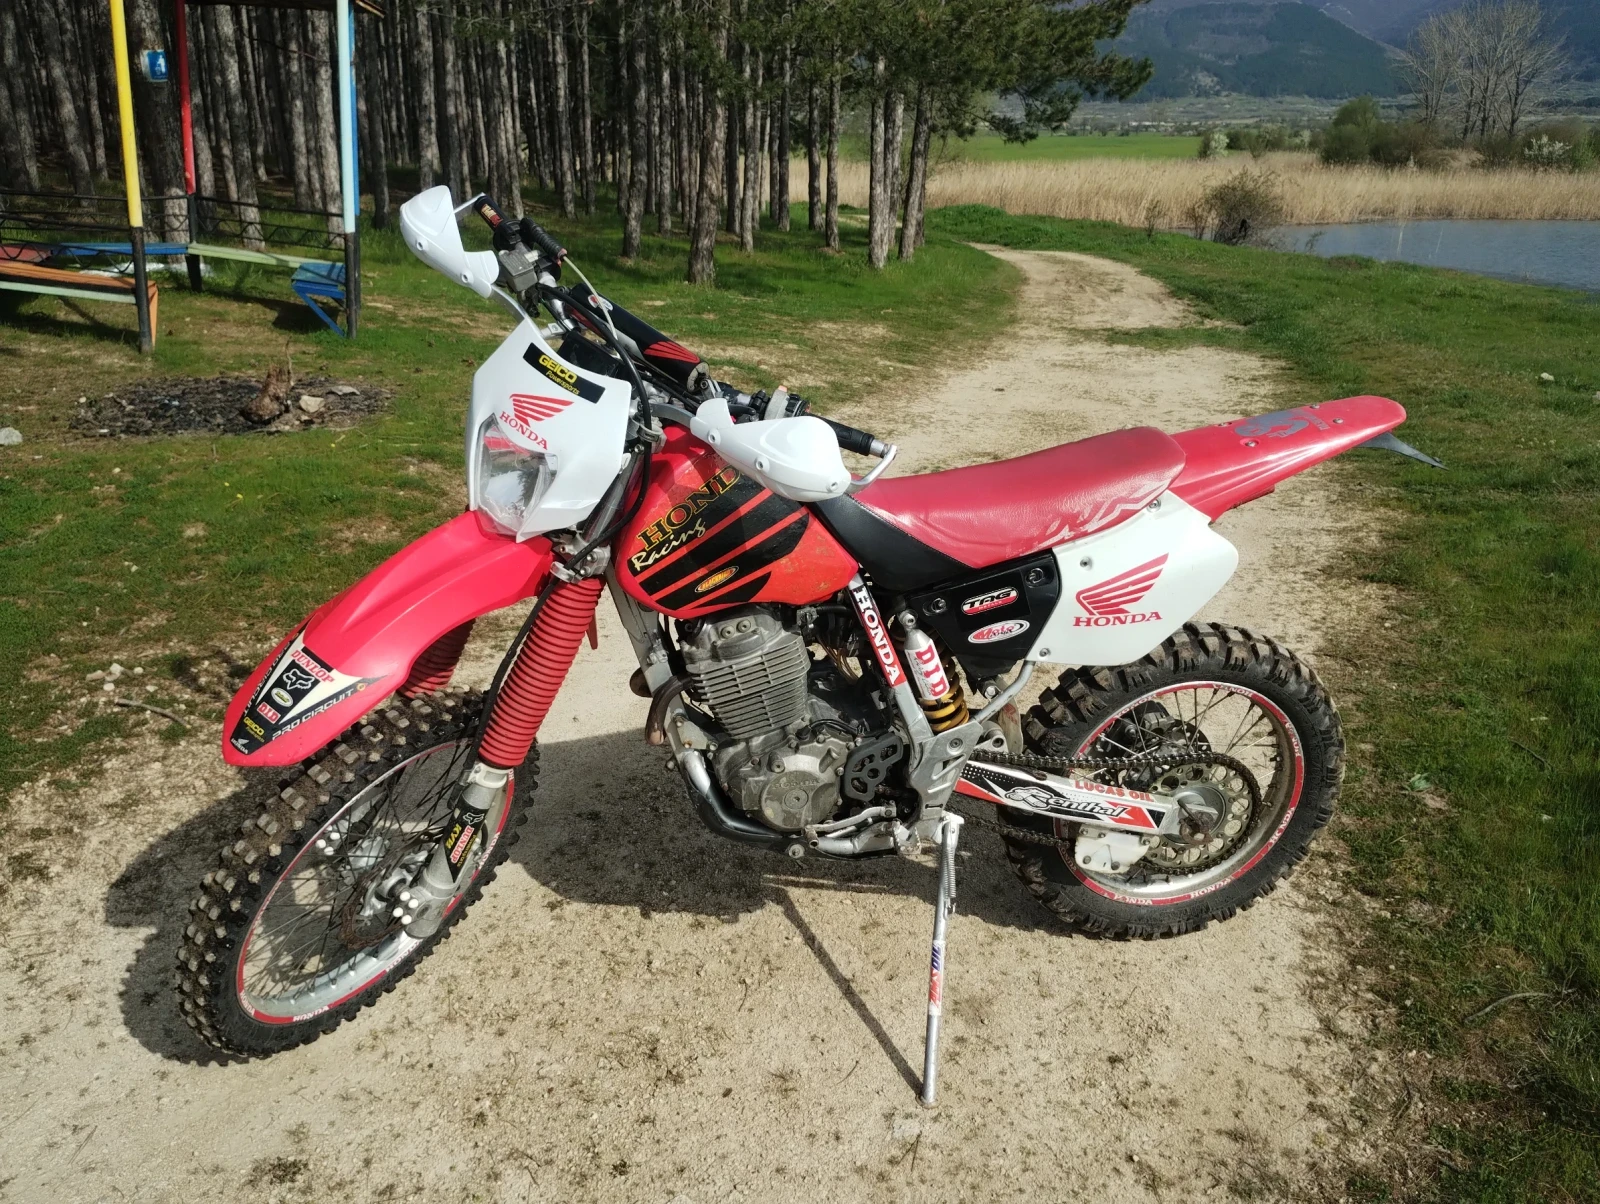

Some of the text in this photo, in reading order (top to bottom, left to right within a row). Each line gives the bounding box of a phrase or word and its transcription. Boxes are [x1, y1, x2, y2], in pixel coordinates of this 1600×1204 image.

[538, 354, 578, 384] GEICO
[546, 370, 581, 396] Powersports
[499, 410, 548, 451] HONDA
[636, 465, 742, 551] HOND
[631, 518, 707, 571] Racing
[964, 588, 1014, 609] TAG
[1073, 611, 1163, 627] HONDA
[853, 585, 901, 685] HONDA
[291, 649, 335, 683] DUNLOP
[915, 644, 948, 697] DID
[244, 717, 265, 736] GEICO
[257, 702, 280, 723] DID
[272, 719, 300, 740] PRO
[302, 688, 354, 723] CIRCUIT
[1075, 780, 1155, 803] LUCAS OIL
[450, 825, 475, 864] DUNLOP
[1190, 878, 1233, 899] HONDA
[293, 1005, 330, 1022] HONDA
